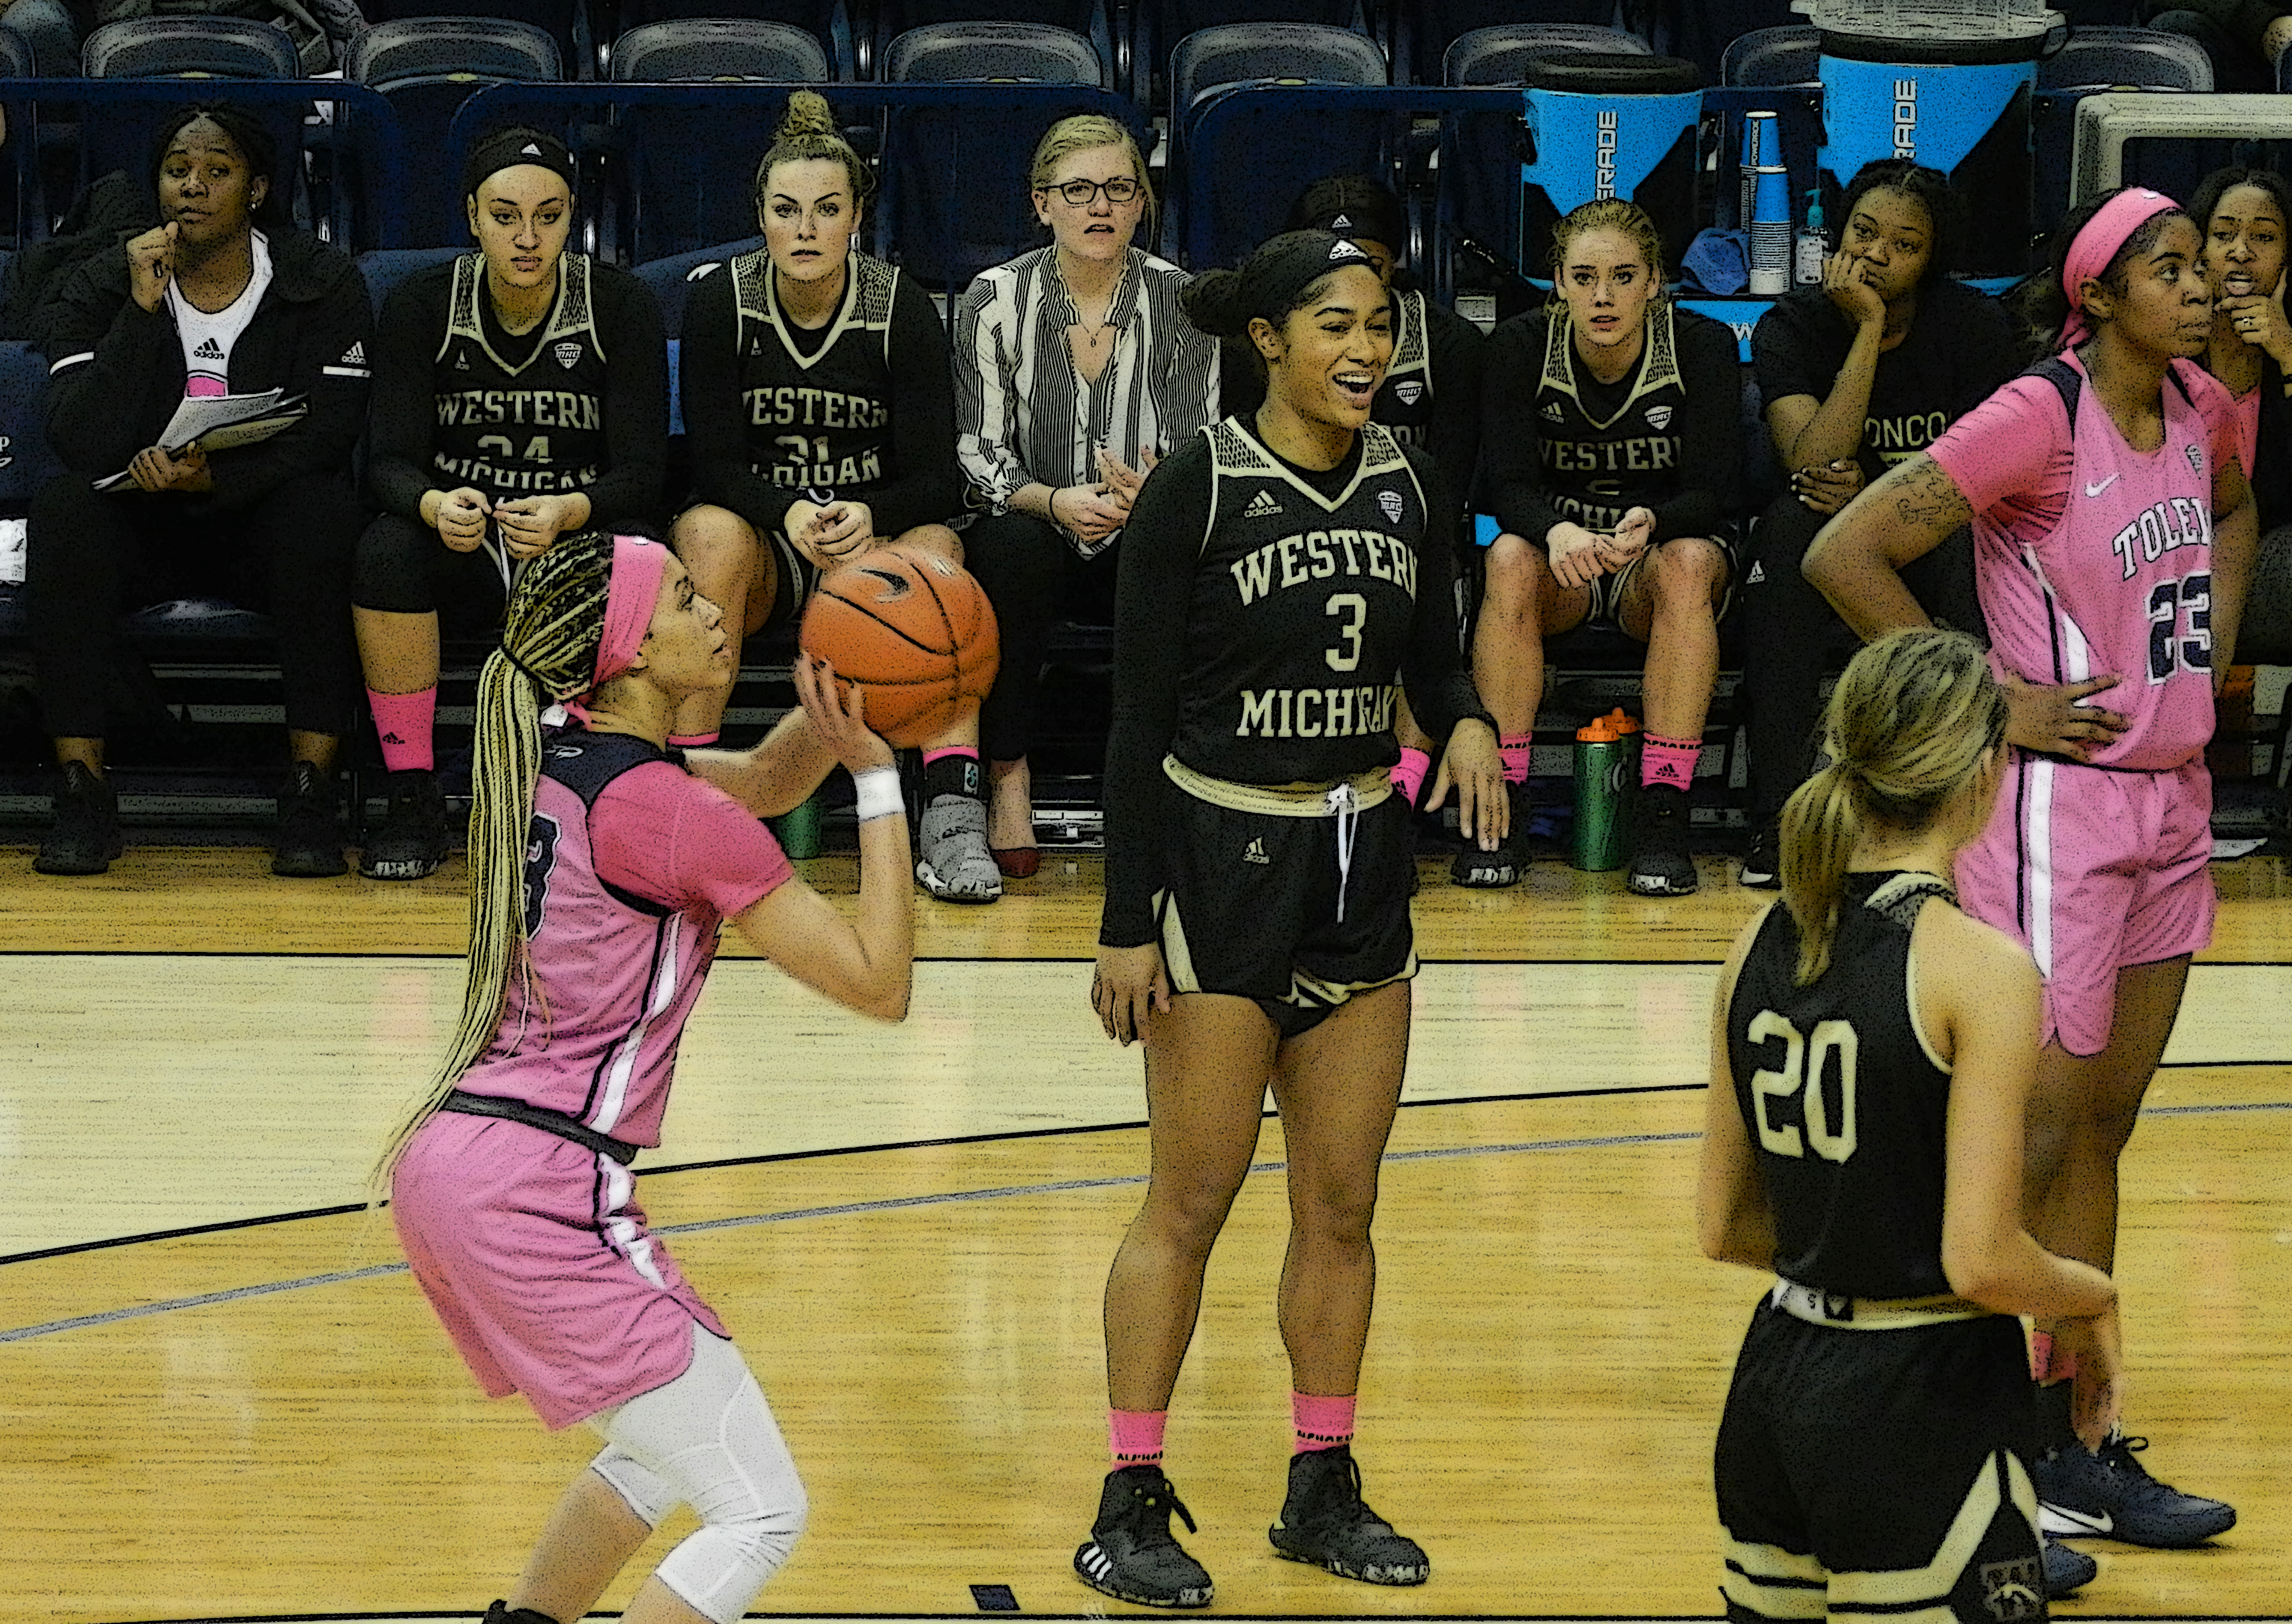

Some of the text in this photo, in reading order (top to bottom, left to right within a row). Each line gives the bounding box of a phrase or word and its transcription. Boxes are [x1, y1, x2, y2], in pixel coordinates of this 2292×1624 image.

[193, 350, 225, 360] adidas
[434, 390, 600, 431] WESTERN
[1244, 504, 1284, 518] adidas
[1325, 593, 1367, 672] 3
[2145, 571, 2214, 685] 23
[1747, 1008, 1858, 1165] 20
